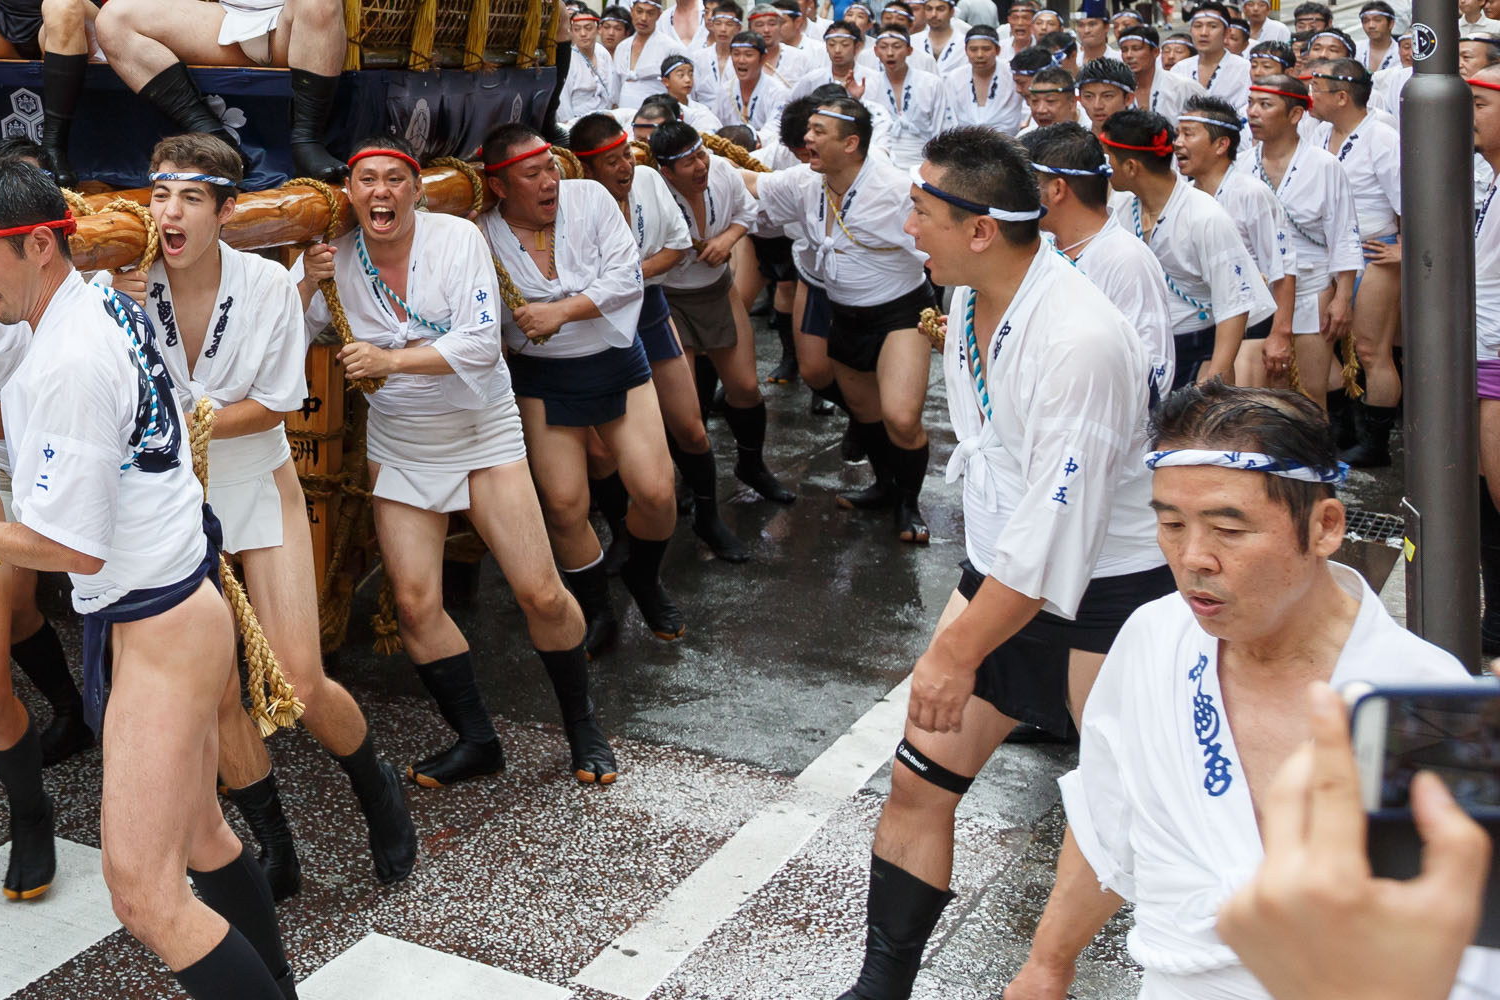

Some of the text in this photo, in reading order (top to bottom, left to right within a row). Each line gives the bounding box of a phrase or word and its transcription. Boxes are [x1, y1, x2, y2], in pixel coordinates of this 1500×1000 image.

[476, 289, 494, 325] 中五
[36, 443, 56, 491] 中二
[1052, 457, 1079, 506] 中五
